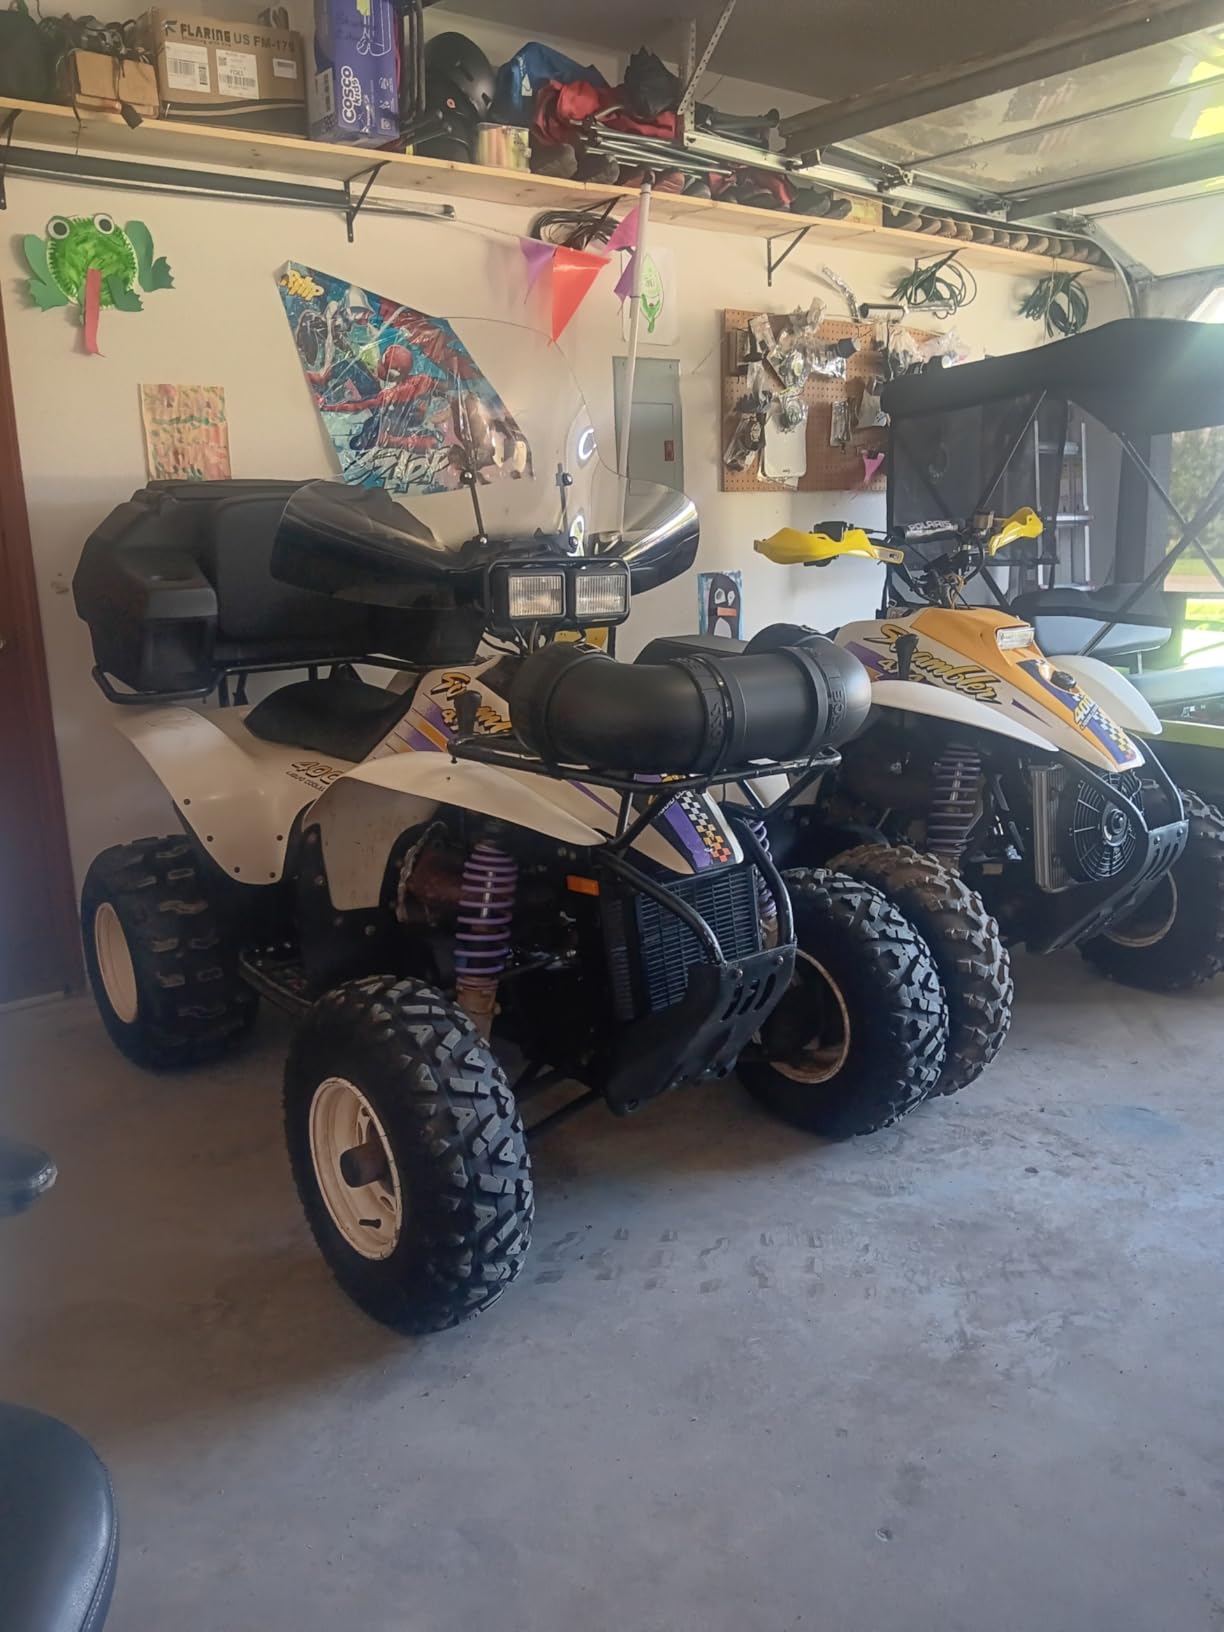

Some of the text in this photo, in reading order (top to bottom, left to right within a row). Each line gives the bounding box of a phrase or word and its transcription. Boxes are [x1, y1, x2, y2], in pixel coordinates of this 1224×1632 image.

[233, 33, 250, 46] US
[352, 78, 361, 107] kids
[908, 520, 952, 531] POLARIS
[863, 623, 1002, 705] Sambler
